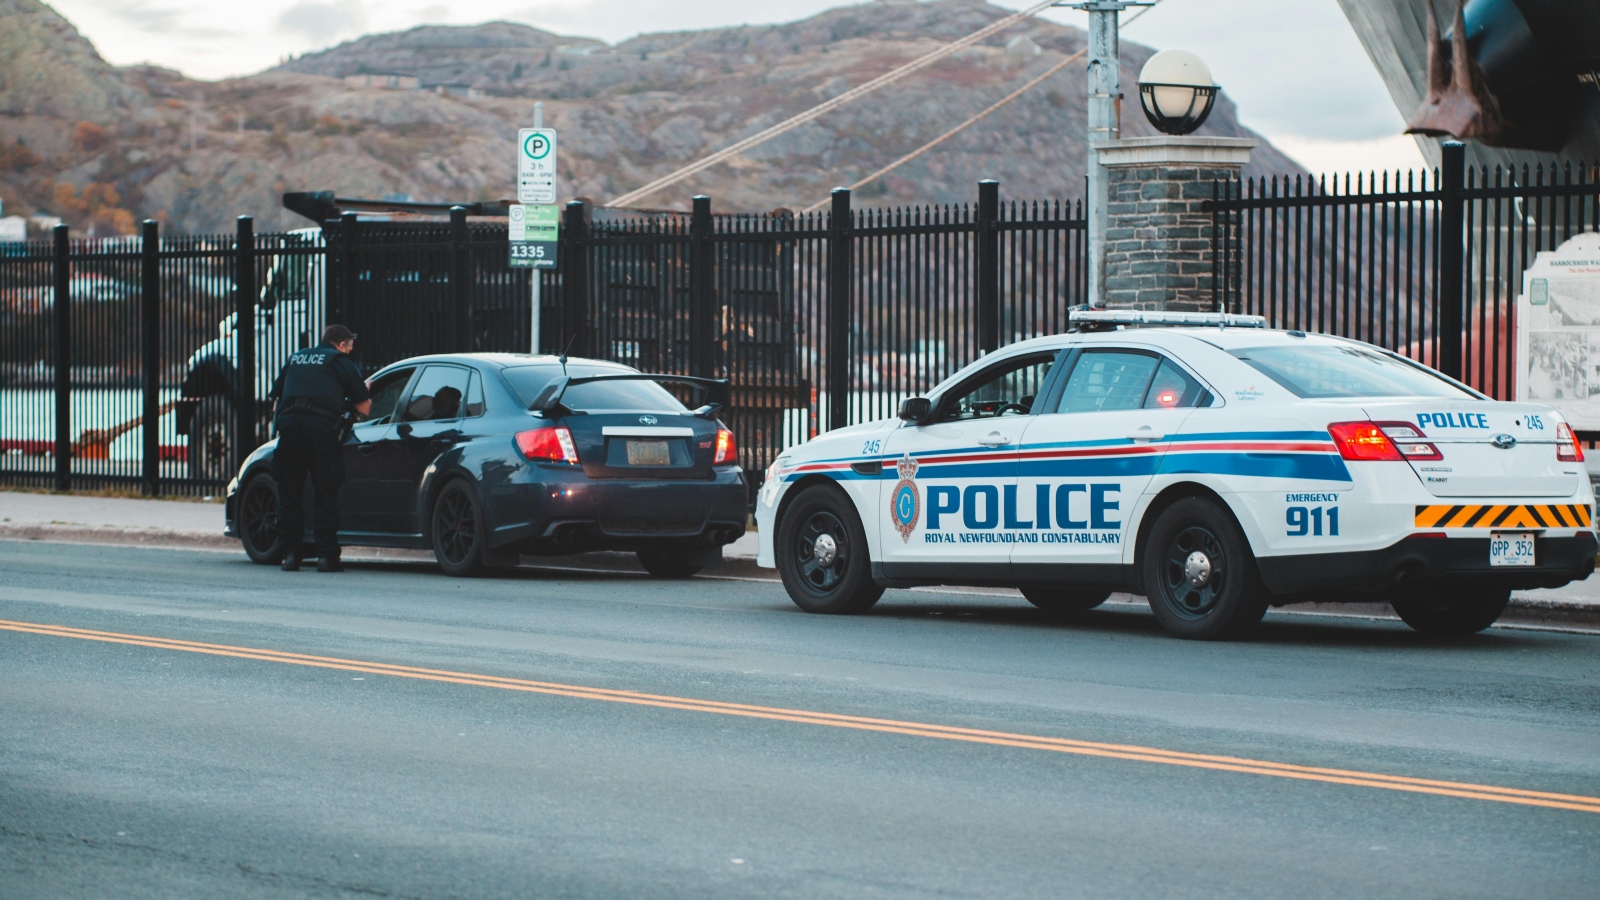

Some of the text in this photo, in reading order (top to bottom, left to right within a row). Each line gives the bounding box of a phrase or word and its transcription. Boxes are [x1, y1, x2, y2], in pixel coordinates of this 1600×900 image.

[532, 139, 544, 154] P
[530, 162, 536, 170] 3
[514, 210, 521, 219] P
[511, 245, 545, 258] 1335
[290, 354, 326, 365] POLICE
[1416, 412, 1489, 429] POLICE
[1524, 415, 1544, 430] 245
[862, 439, 881, 454] 245
[1286, 493, 1339, 502] EMERGENCY
[899, 493, 911, 518] C
[926, 484, 1122, 530] POLICE
[1286, 506, 1339, 536] 911
[925, 533, 1121, 544] ROYAL NEWFOUNDLAND CONSTABULARY
[1492, 541, 1533, 556] GPP 352
